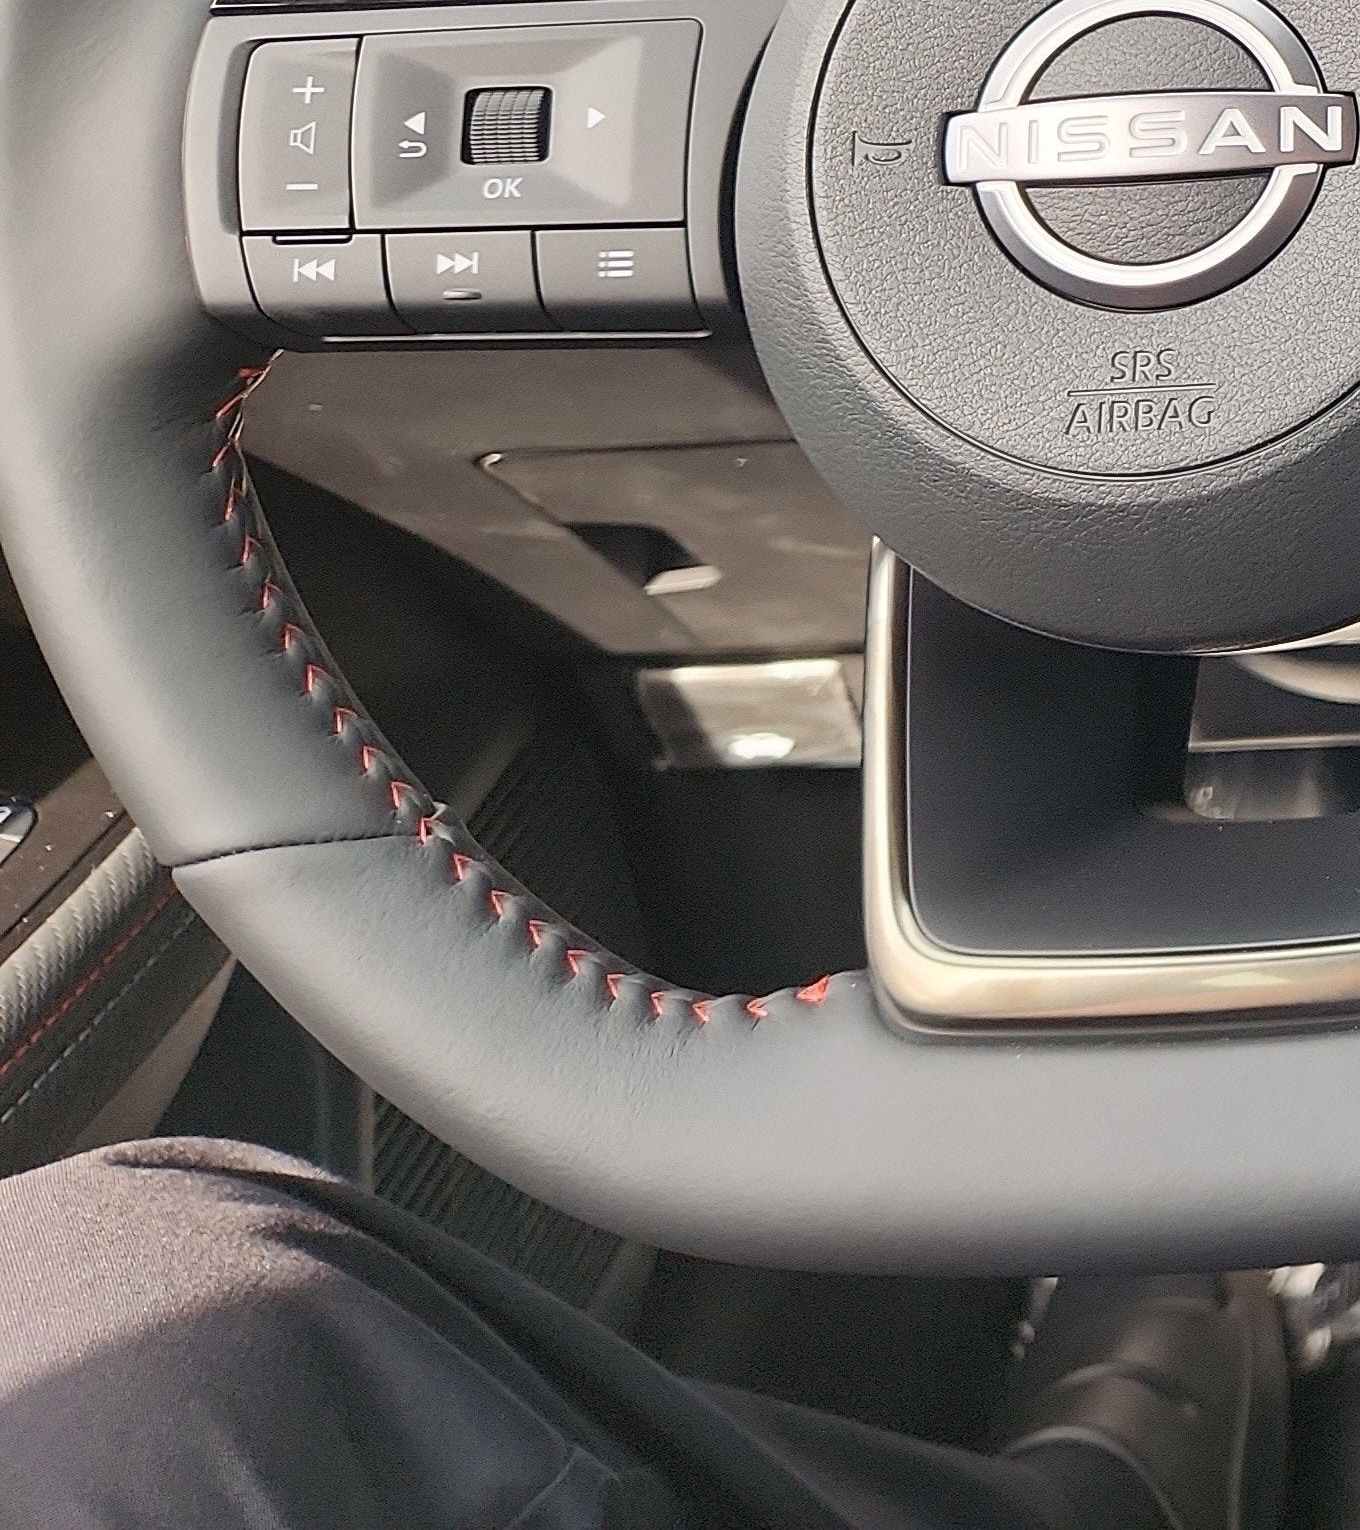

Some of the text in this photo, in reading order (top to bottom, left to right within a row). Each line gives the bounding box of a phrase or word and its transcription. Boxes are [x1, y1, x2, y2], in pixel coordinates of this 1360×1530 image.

[956, 103, 1344, 171] NISSAN
[482, 178, 523, 200] OK
[1110, 348, 1177, 385] SRS
[1066, 396, 1217, 436] AIRBAG
